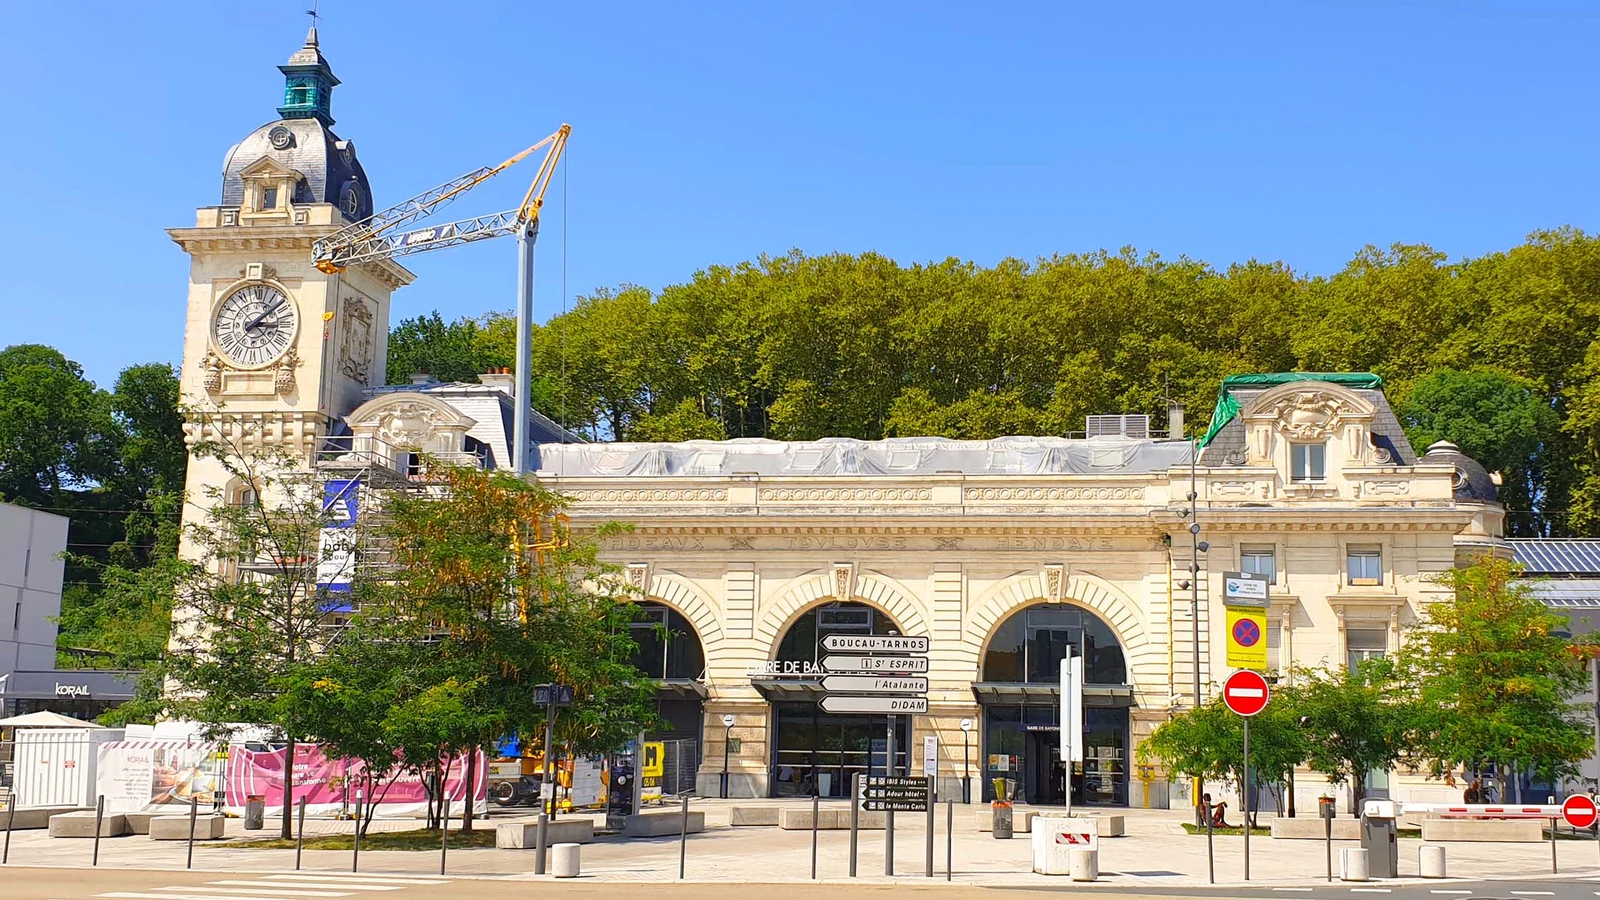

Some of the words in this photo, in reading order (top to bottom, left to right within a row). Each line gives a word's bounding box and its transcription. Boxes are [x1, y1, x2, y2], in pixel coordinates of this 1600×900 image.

[996, 537, 1113, 549] HENDAYE
[832, 638, 925, 649] BOUCAU-TARNOS
[784, 660, 801, 674] DE
[889, 660, 925, 669] ESPRIT
[874, 680, 925, 689] l'Atalante
[55, 682, 90, 699] KORAIL
[891, 700, 925, 710] DIDAM
[886, 789, 904, 797] Adour
[910, 802, 926, 810] Carlo
